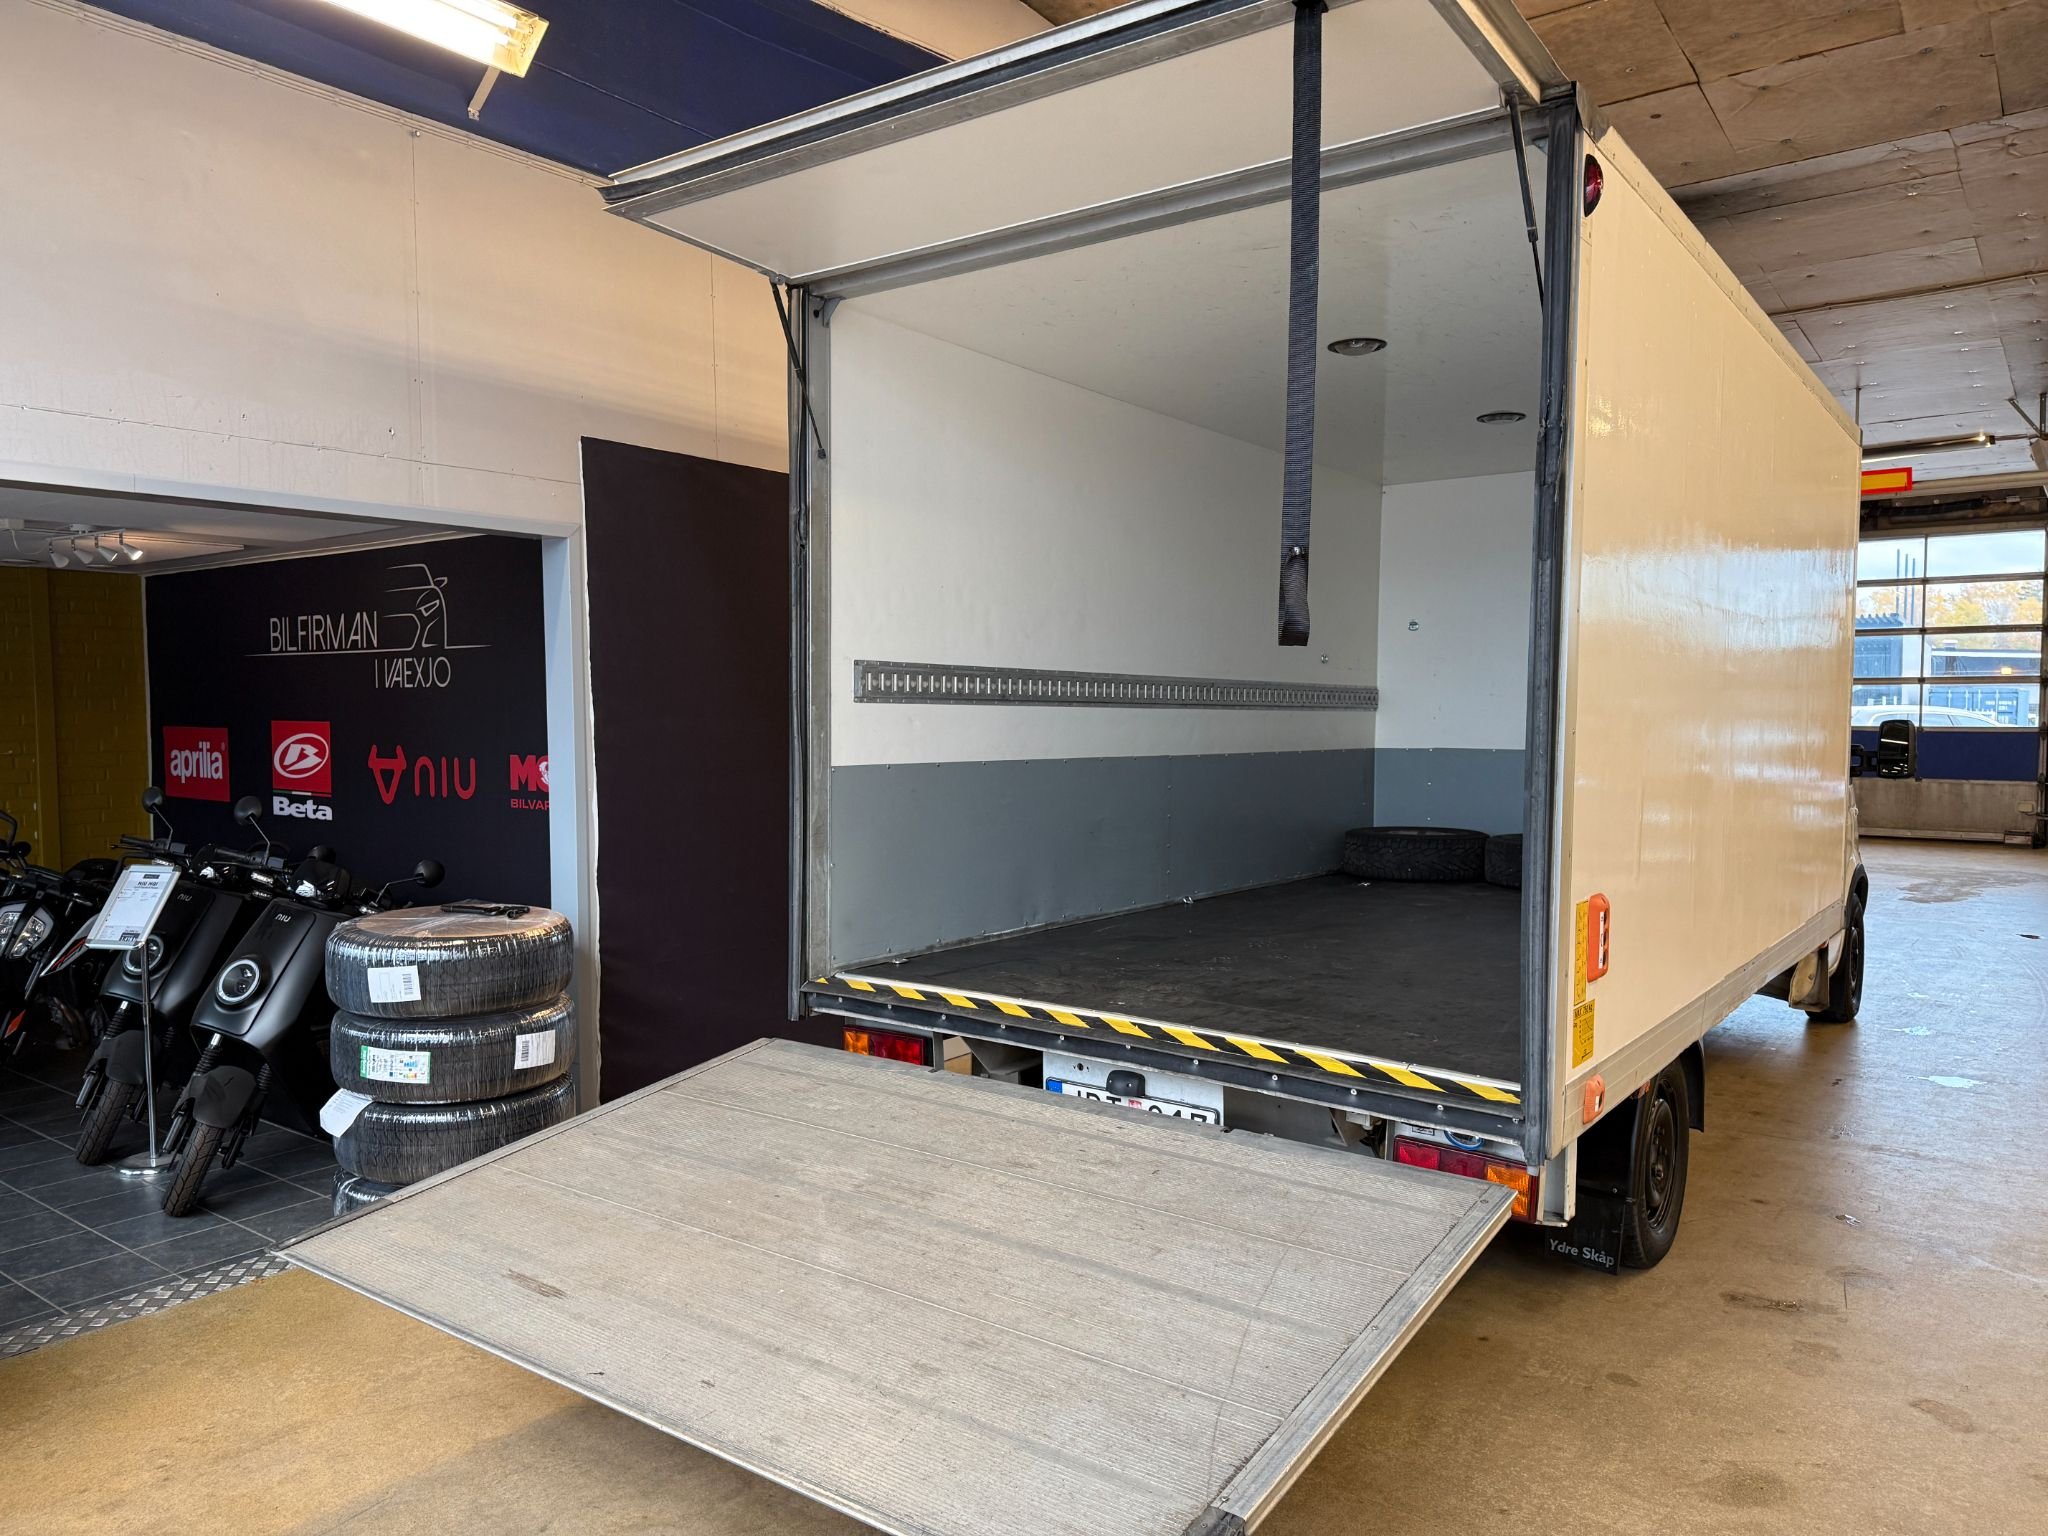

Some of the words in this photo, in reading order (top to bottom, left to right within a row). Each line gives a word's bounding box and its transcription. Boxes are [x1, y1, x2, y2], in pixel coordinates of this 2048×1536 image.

[270, 610, 378, 652] BILFIRMAN
[384, 656, 451, 689] VAEXJO
[170, 740, 223, 784] aprilia
[272, 796, 333, 821] Beta
[1549, 1238, 1579, 1256] Ydre
[1582, 1246, 1615, 1268] Skåp
